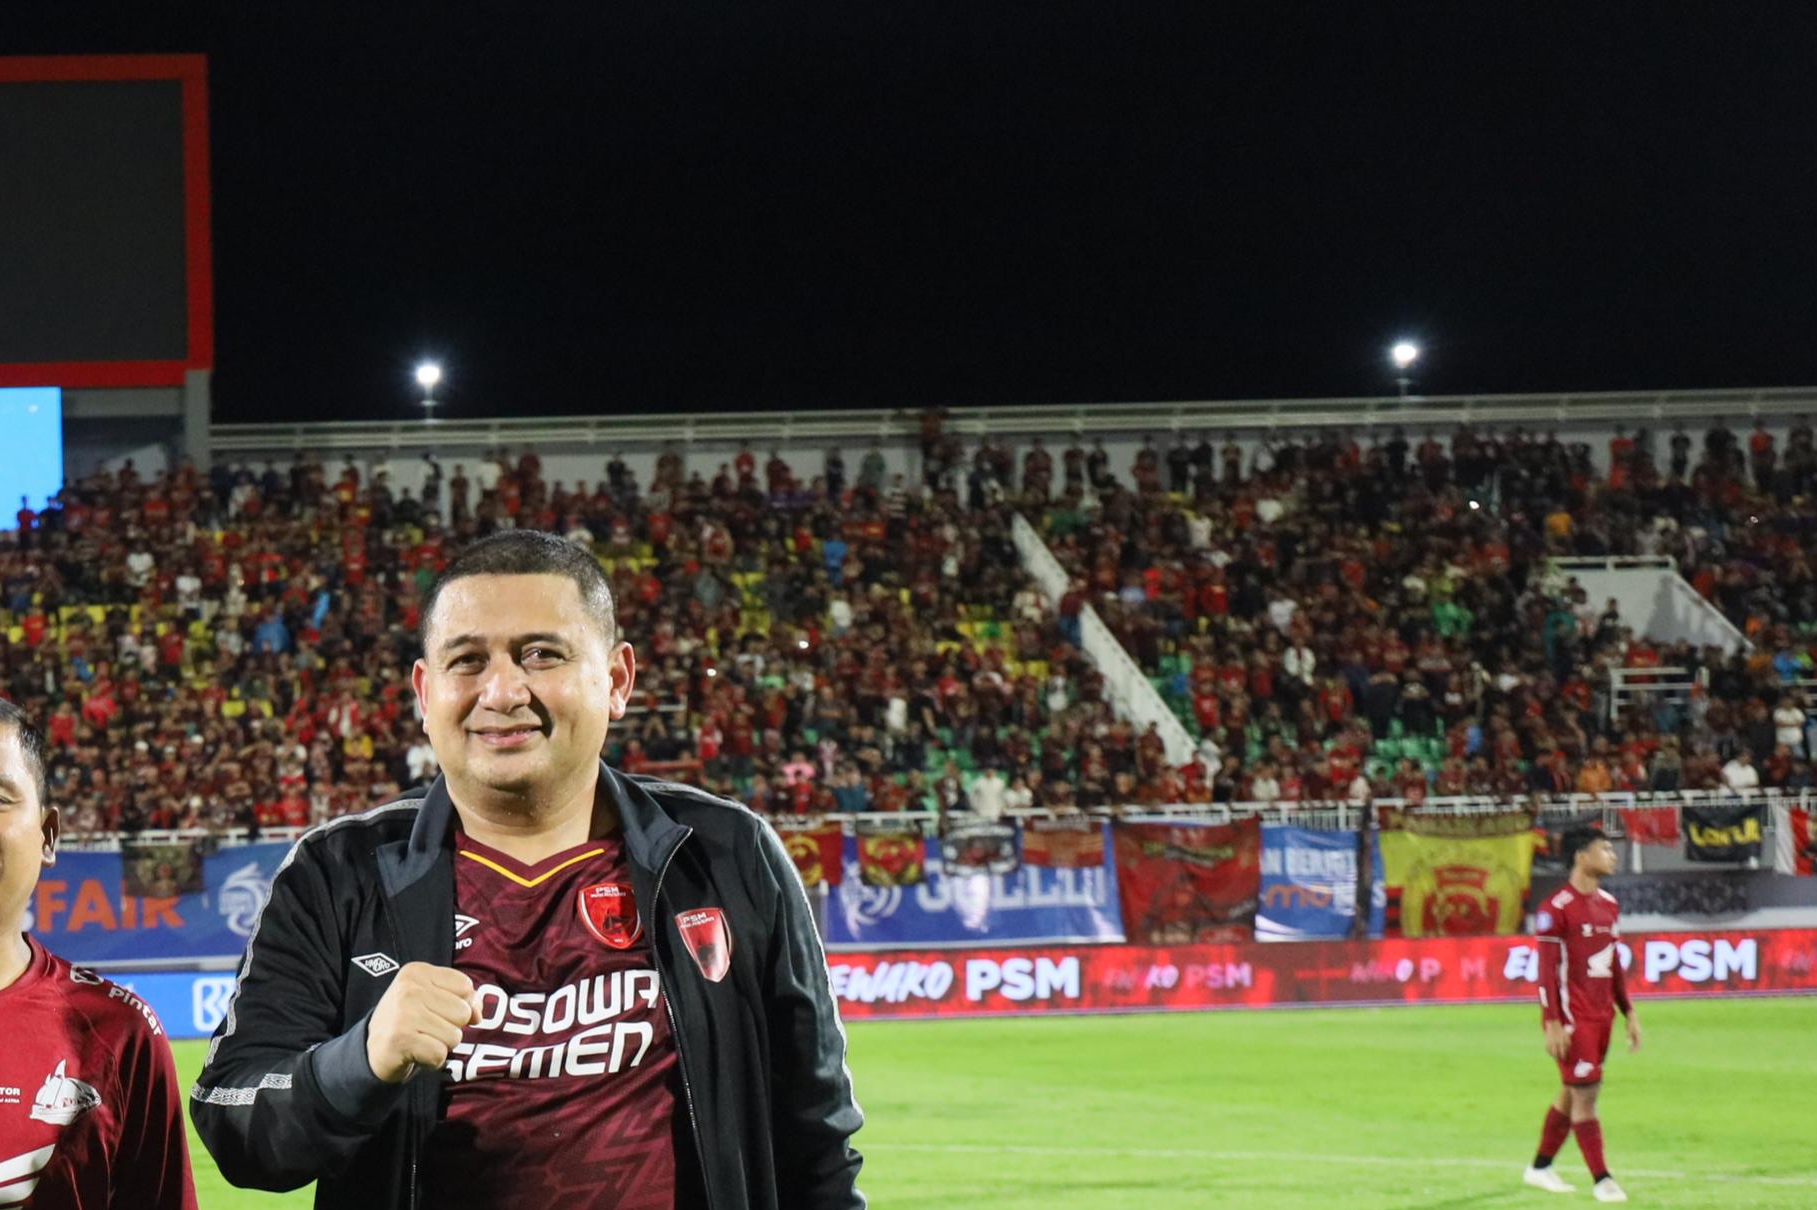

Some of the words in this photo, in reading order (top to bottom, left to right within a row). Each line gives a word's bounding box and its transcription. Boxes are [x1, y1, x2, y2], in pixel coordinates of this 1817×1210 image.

[966, 956, 1080, 1001] PSM
[1644, 938, 1758, 983] PSM
[108, 986, 163, 1036] Pintar
[469, 970, 661, 1034] OSOWA
